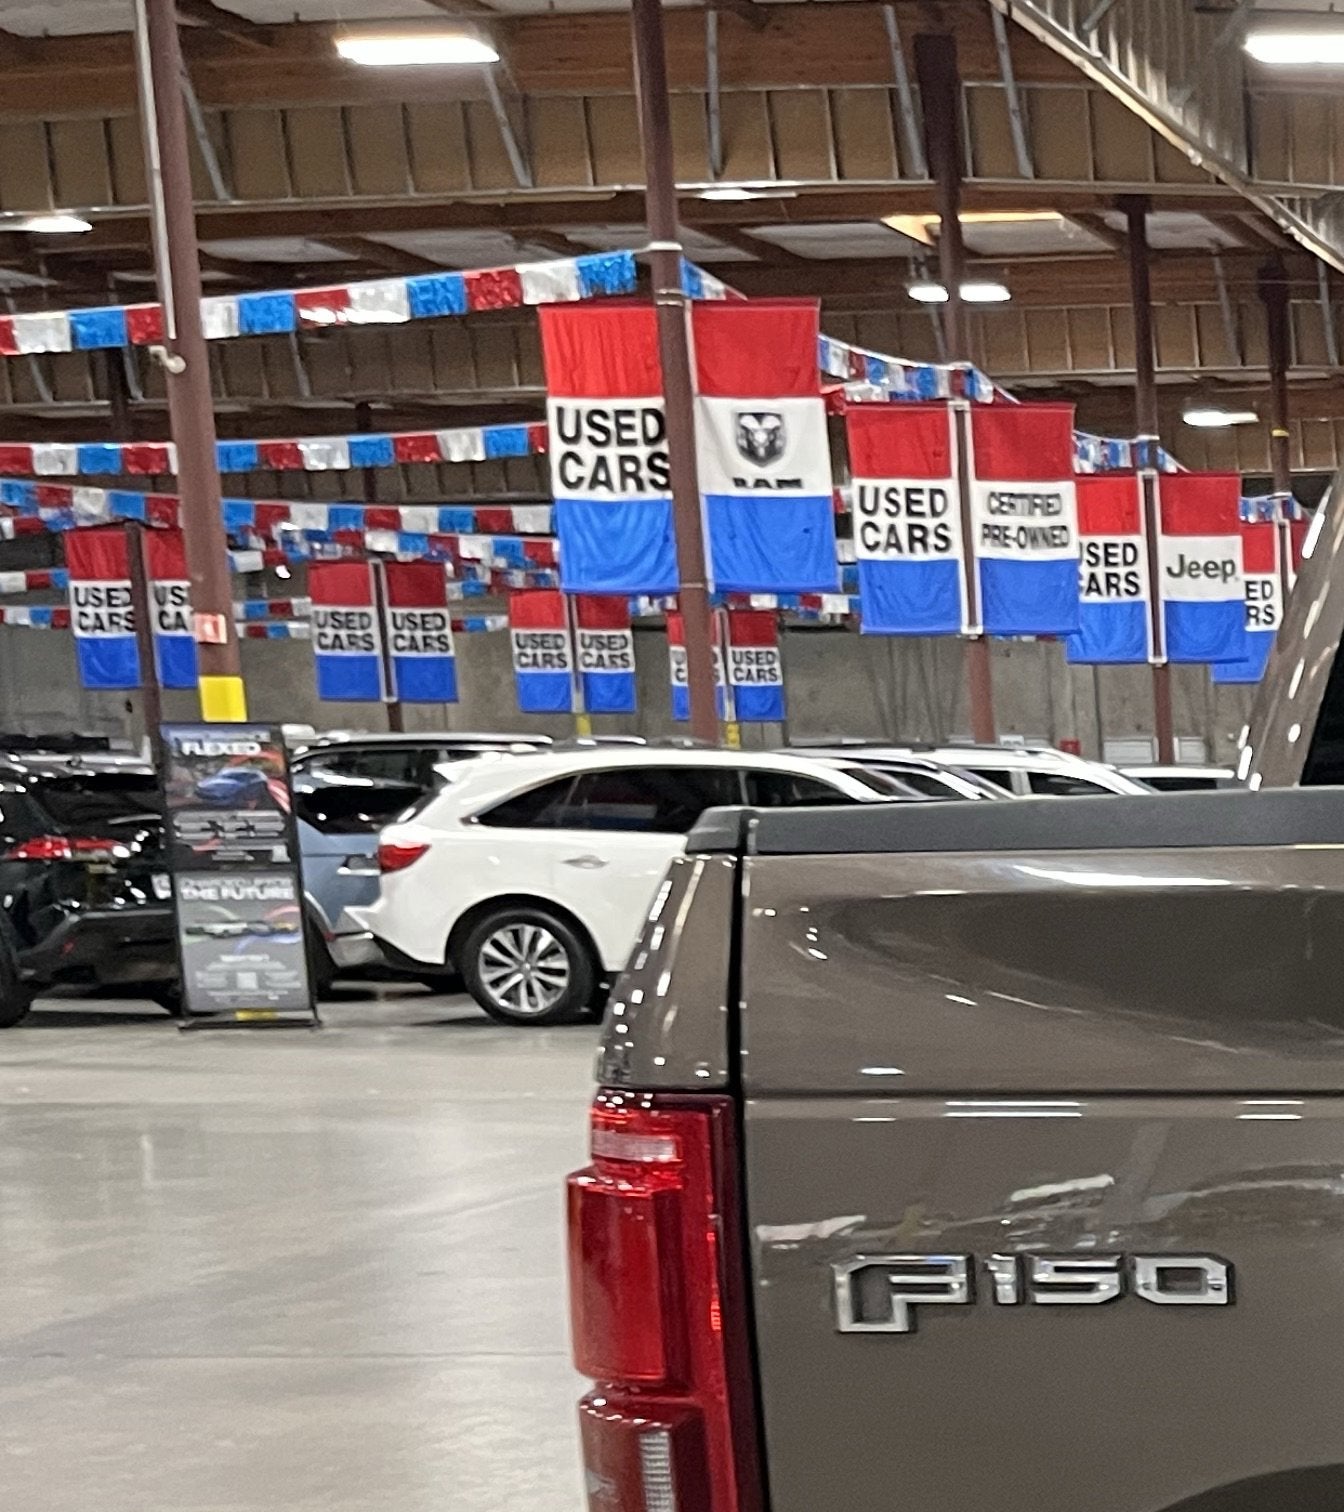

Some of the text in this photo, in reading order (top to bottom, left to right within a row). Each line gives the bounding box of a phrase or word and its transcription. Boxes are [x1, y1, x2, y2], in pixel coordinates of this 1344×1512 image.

[556, 406, 665, 448] USED
[559, 451, 670, 492] CARS
[858, 485, 948, 518] USED
[860, 521, 951, 554] CARS
[981, 523, 1070, 549] PRE-OWNED
[1079, 541, 1138, 568] SED
[1166, 554, 1236, 583] Jeep
[1080, 571, 1140, 597] ARS
[74, 586, 132, 608] USED
[78, 611, 136, 632] CARS
[315, 610, 372, 631] USED
[391, 611, 447, 631] USED
[317, 632, 375, 652] CARS
[393, 634, 450, 653] CARS
[515, 632, 566, 650] USED
[580, 633, 629, 651] USED
[731, 650, 777, 666] USED
[733, 667, 778, 682] CARS
